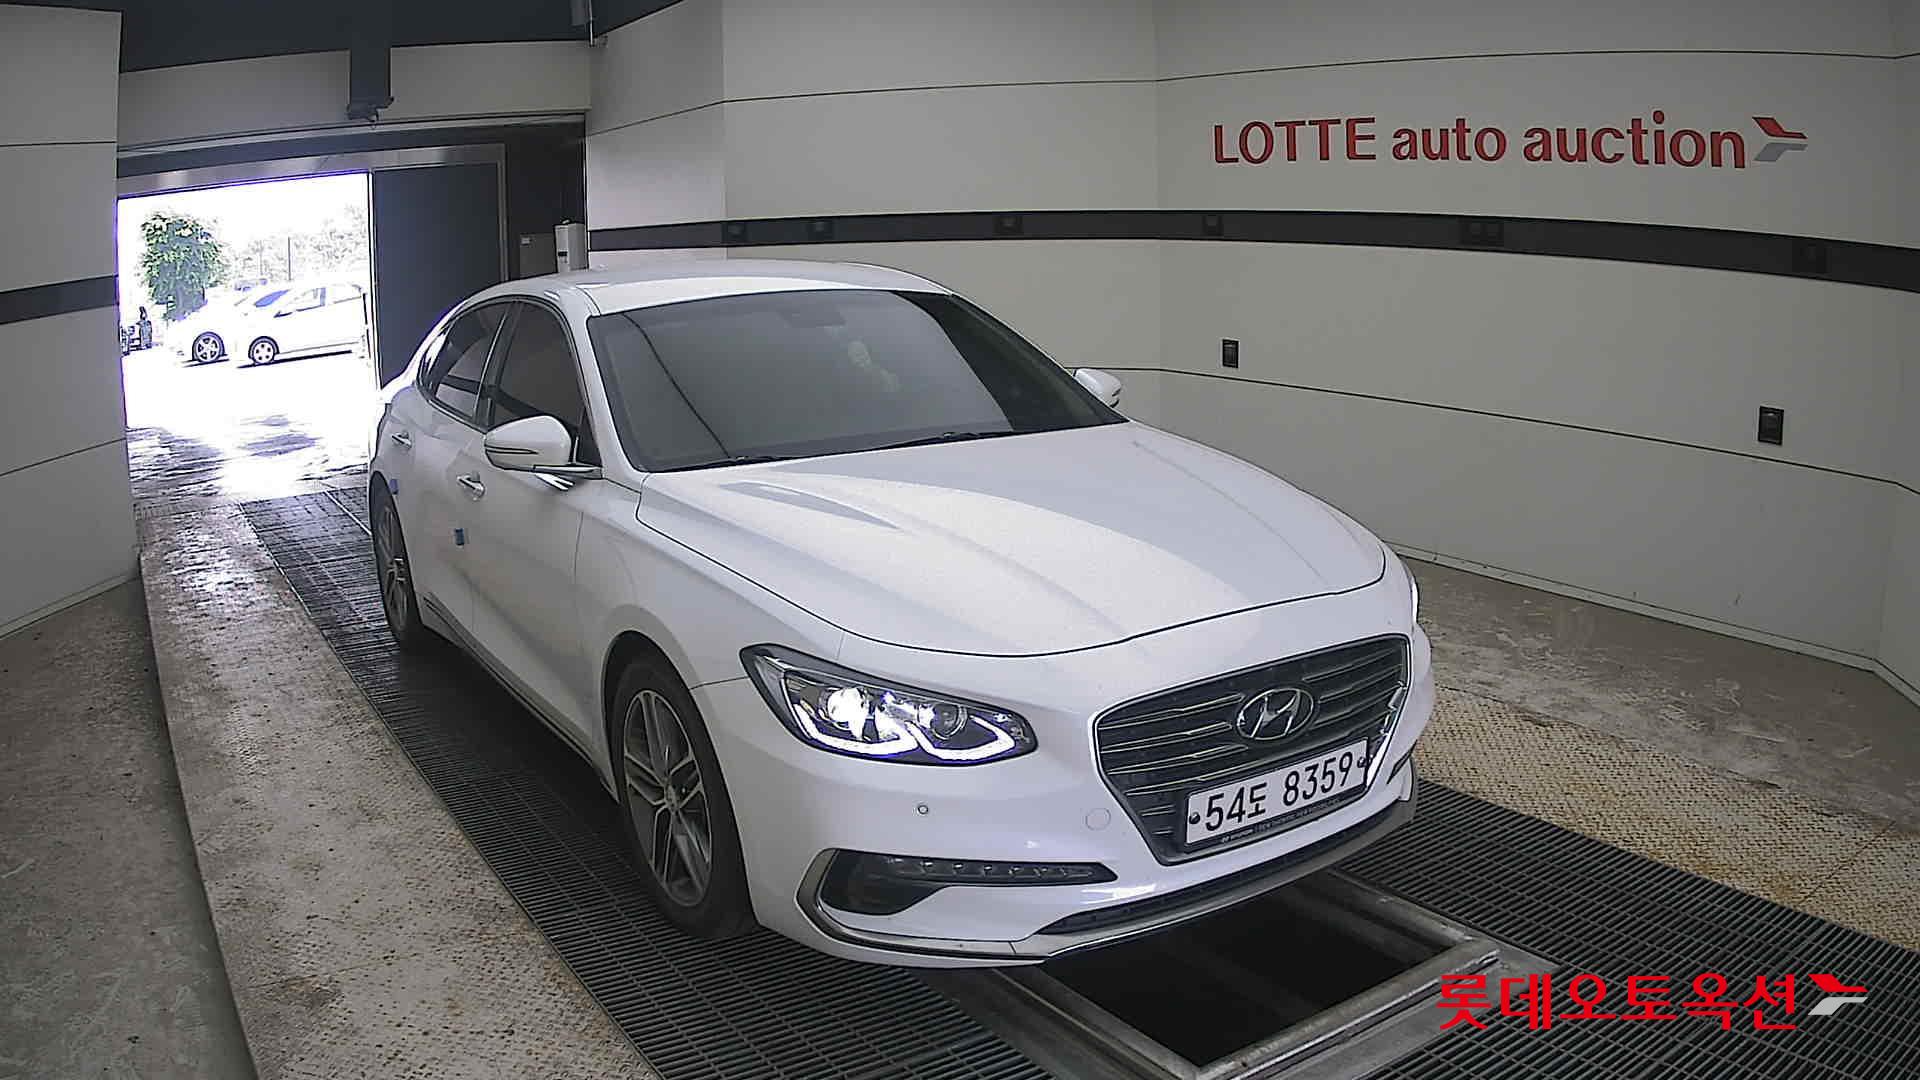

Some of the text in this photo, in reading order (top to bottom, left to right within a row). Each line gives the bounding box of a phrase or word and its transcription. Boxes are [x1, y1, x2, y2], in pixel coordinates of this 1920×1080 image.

[1213, 110, 1746, 169] LOTTE auto auction
[1205, 782, 1267, 832] 54도
[1283, 751, 1353, 807] 8359
